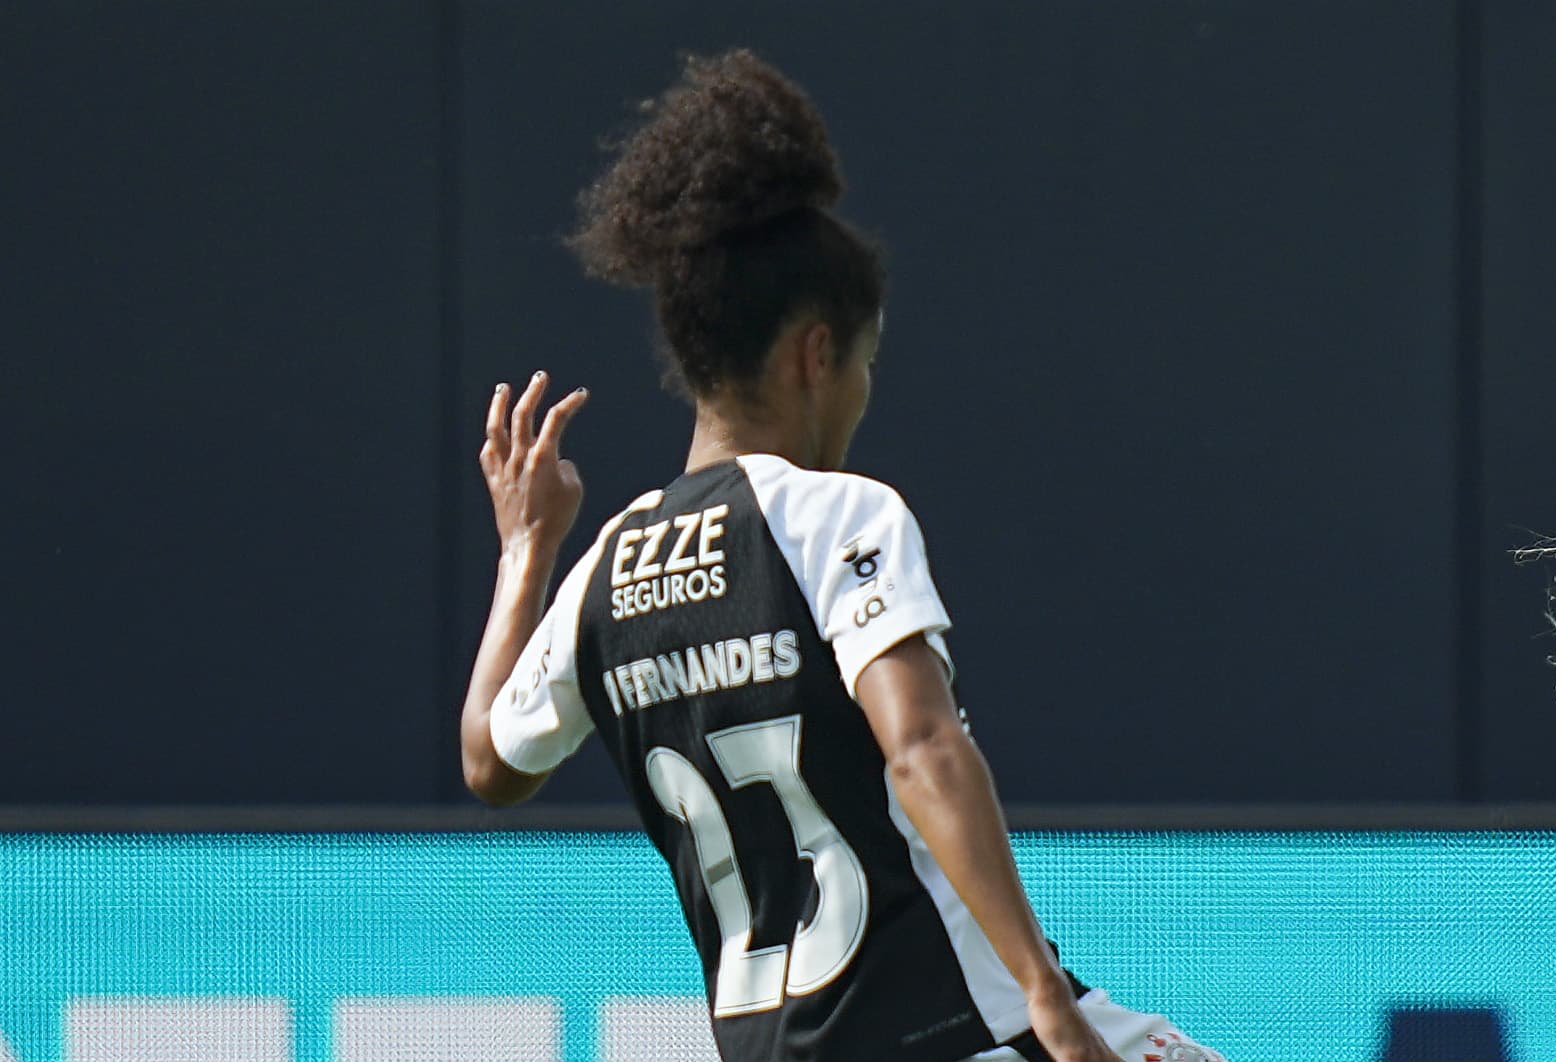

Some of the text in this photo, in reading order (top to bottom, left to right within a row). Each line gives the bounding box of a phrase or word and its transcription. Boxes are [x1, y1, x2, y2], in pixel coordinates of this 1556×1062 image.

[611, 504, 729, 589] EZZE
[611, 565, 728, 621] SEGUROS
[615, 628, 800, 711] FERNANDES
[646, 714, 869, 1018] 23
